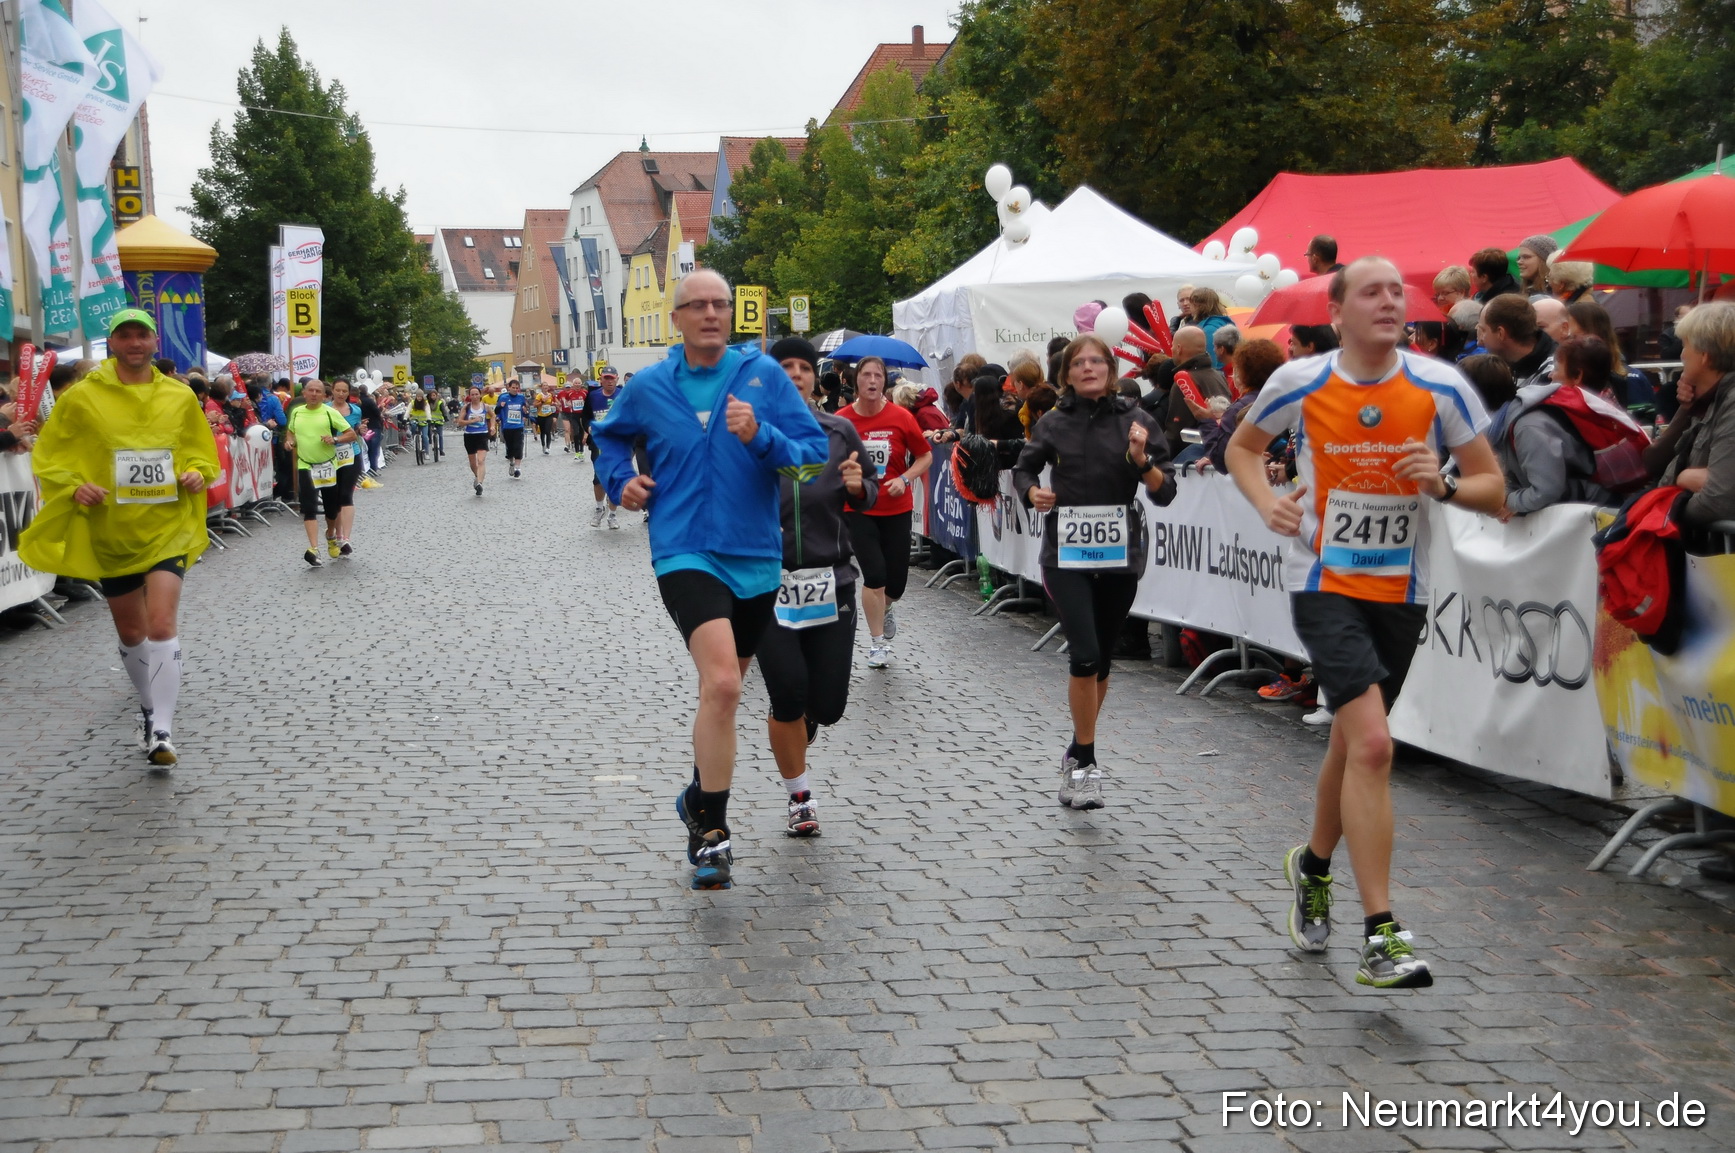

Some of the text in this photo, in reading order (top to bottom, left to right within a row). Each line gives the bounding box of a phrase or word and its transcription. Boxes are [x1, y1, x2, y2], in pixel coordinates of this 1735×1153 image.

[290, 291, 315, 300] Block
[740, 288, 763, 297] Block
[295, 303, 312, 326] B
[744, 300, 758, 322] B
[995, 329, 1046, 344] Kinder
[396, 370, 404, 381] C
[129, 464, 165, 484] 298
[130, 488, 166, 497] Christian
[1329, 498, 1405, 511] PARTL Neumarkt
[1065, 521, 1121, 544] 2965
[1332, 512, 1409, 545] 2413
[1081, 549, 1104, 559] Petra
[1155, 521, 1284, 597] BMW Laufsport
[1351, 552, 1385, 565] David
[779, 581, 829, 605] 3127
[1417, 588, 1482, 663] KK
